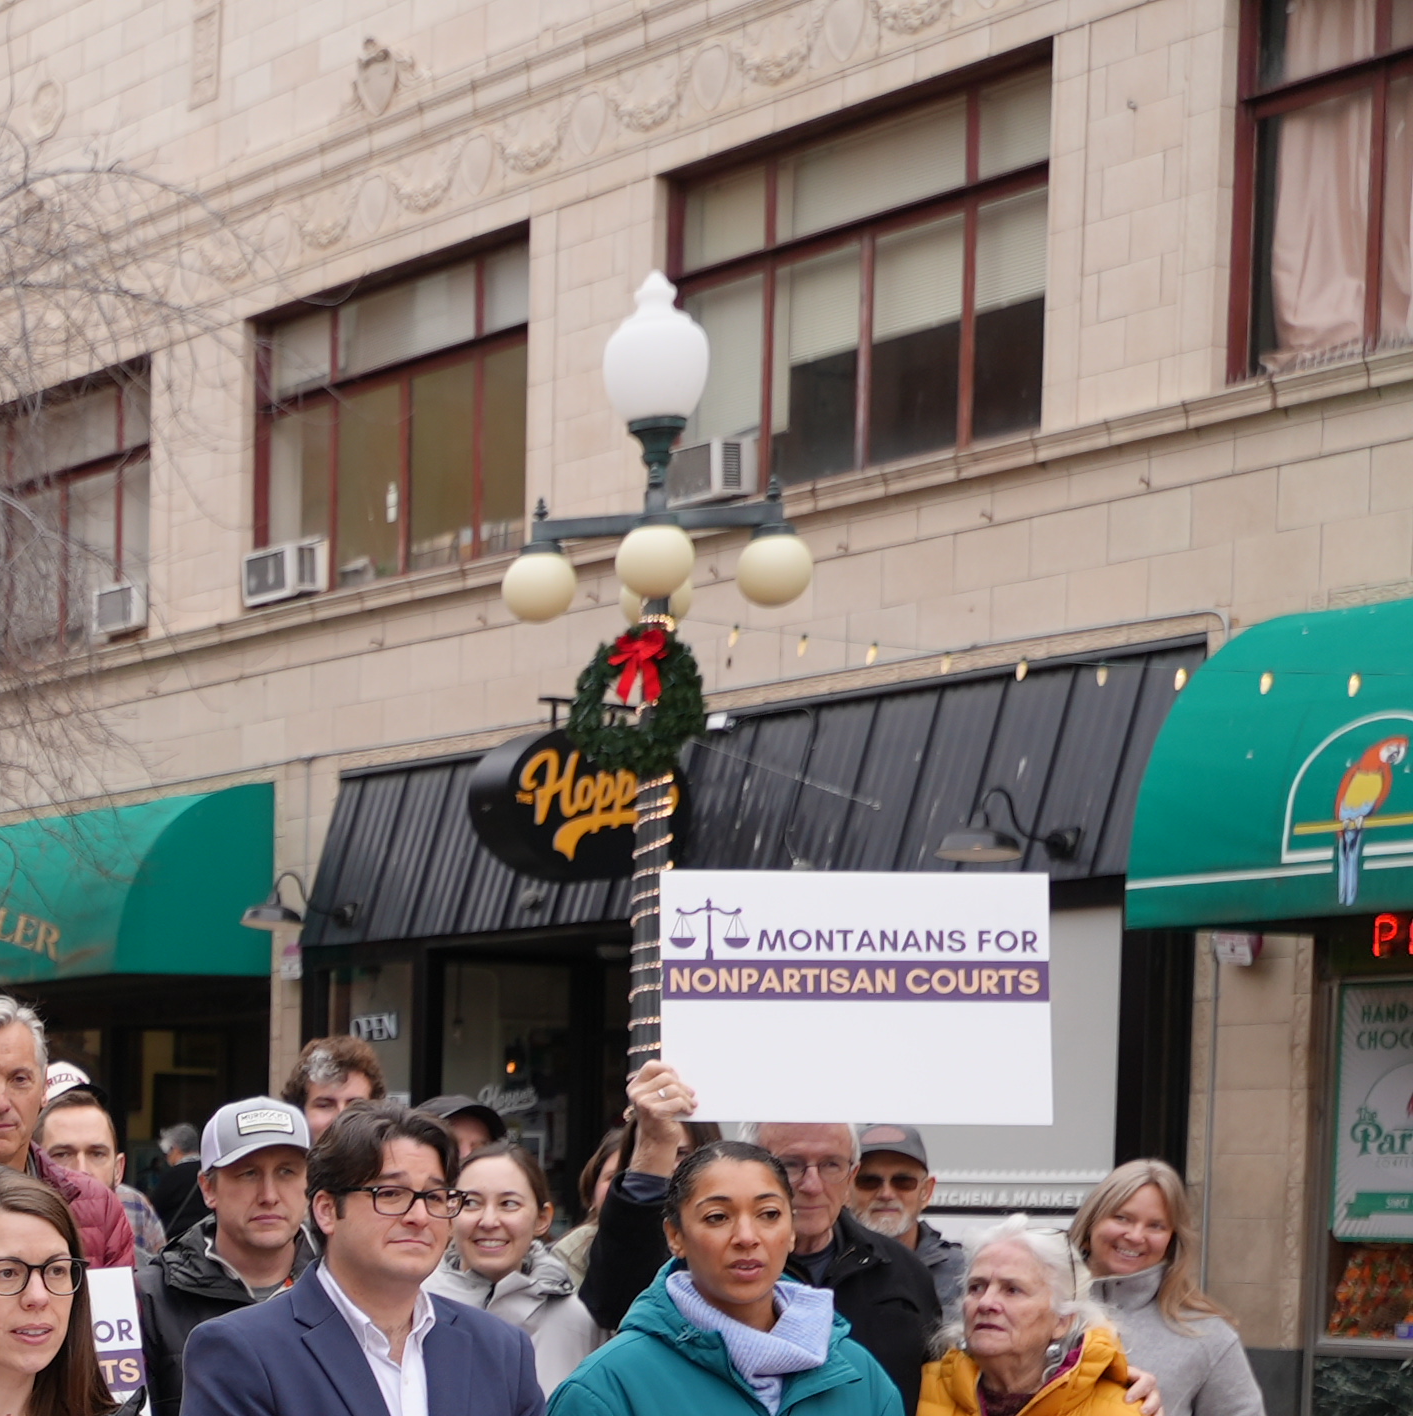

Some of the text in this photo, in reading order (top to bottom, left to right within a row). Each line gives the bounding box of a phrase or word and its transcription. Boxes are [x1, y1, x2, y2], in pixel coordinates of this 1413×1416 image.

[519, 748, 681, 833] Hopp
[756, 929, 1038, 954] MONTANANS FOR
[669, 966, 1040, 995] NONPARTISAN COURTS
[349, 1011, 399, 1041] OPEN
[92, 1318, 135, 1343] OR
